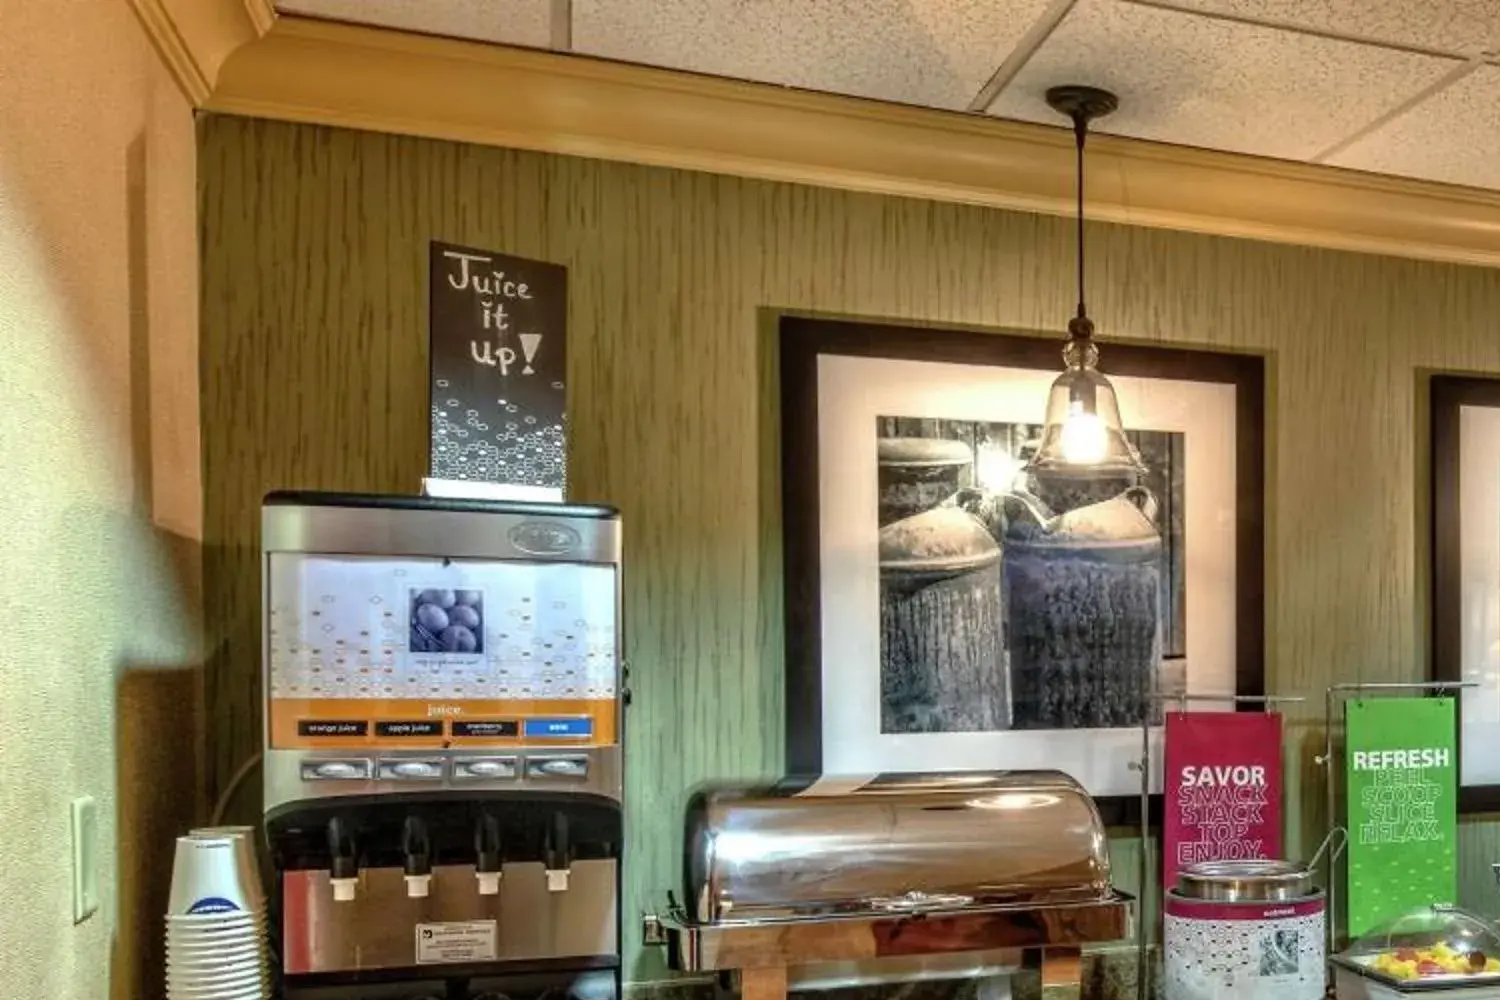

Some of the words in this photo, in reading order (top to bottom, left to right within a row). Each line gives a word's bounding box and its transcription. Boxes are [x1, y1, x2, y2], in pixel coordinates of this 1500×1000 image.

[444, 251, 533, 299] Juice
[481, 300, 508, 330] it
[1353, 747, 1449, 771] REFRESH
[1181, 765, 1265, 787] SAVOR
[1178, 784, 1269, 806] SNACK
[1181, 802, 1264, 825] STACK
[1197, 821, 1249, 843] TOP
